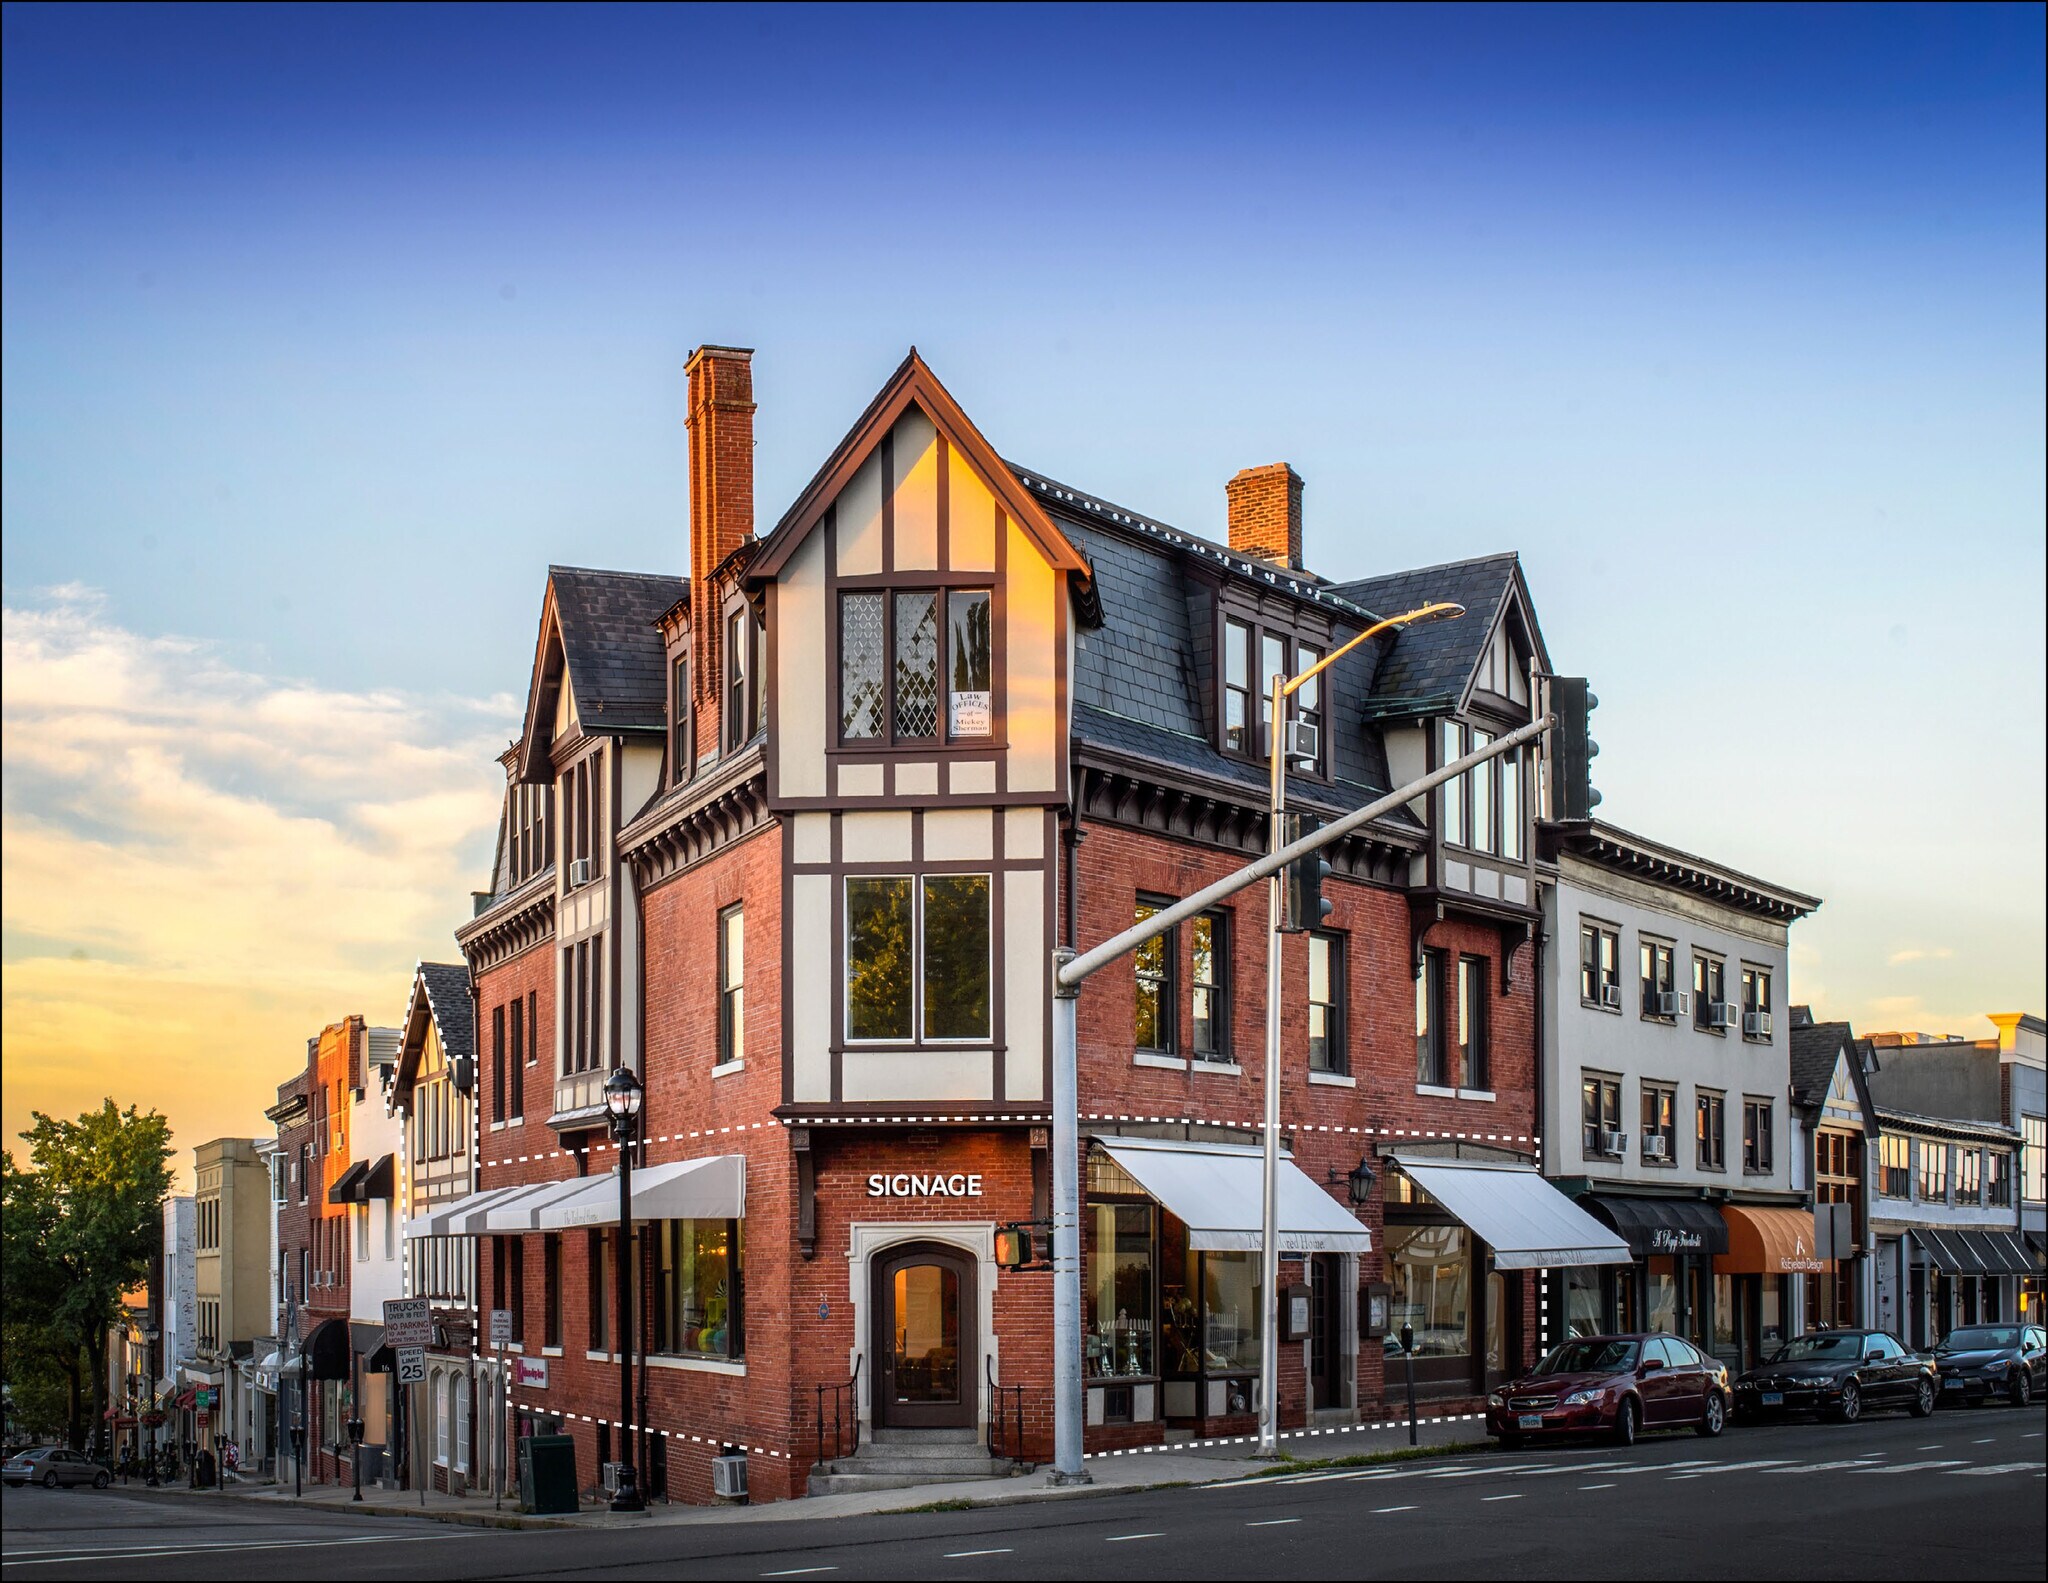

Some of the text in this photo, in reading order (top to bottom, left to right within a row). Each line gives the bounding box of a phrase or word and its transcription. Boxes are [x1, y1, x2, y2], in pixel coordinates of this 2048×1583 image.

[952, 700, 988, 710] OFFICES
[868, 1174, 983, 1196] SIGNAGE
[1806, 1257, 1824, 1272] Design
[388, 1301, 426, 1313] TRUCKS
[387, 1321, 429, 1331] NO PARKING
[399, 1349, 422, 1357] SPEED
[381, 1364, 390, 1372] 16
[401, 1364, 423, 1380] 25
